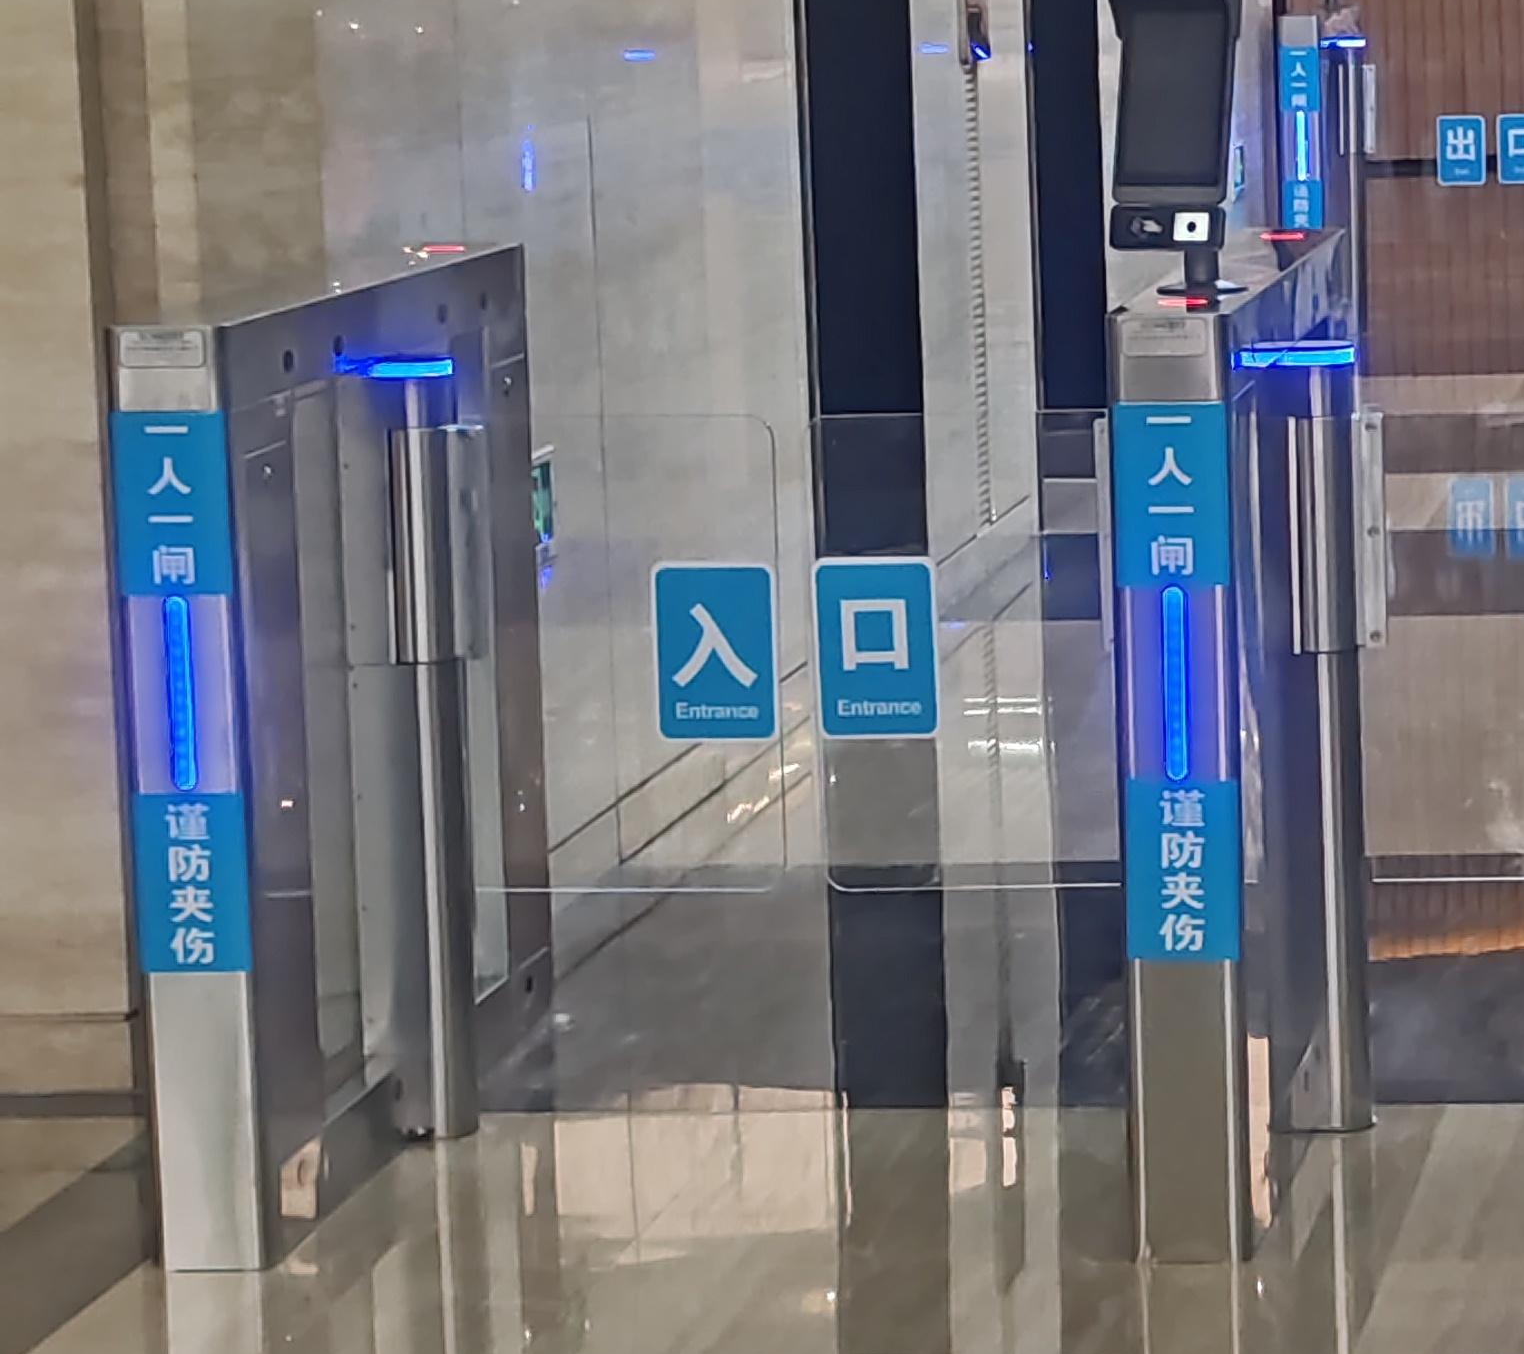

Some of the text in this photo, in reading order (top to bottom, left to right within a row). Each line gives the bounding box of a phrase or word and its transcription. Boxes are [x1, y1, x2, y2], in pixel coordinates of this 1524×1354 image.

[144, 425, 197, 585] 一人一闸
[1147, 415, 1195, 576] 一人一闸
[672, 598, 910, 688] 入 口
[676, 701, 760, 720] Entrance
[838, 698, 922, 717] Entrance
[165, 803, 216, 965] 谨防夹伤
[1159, 789, 1206, 952] 谨防夹伤
